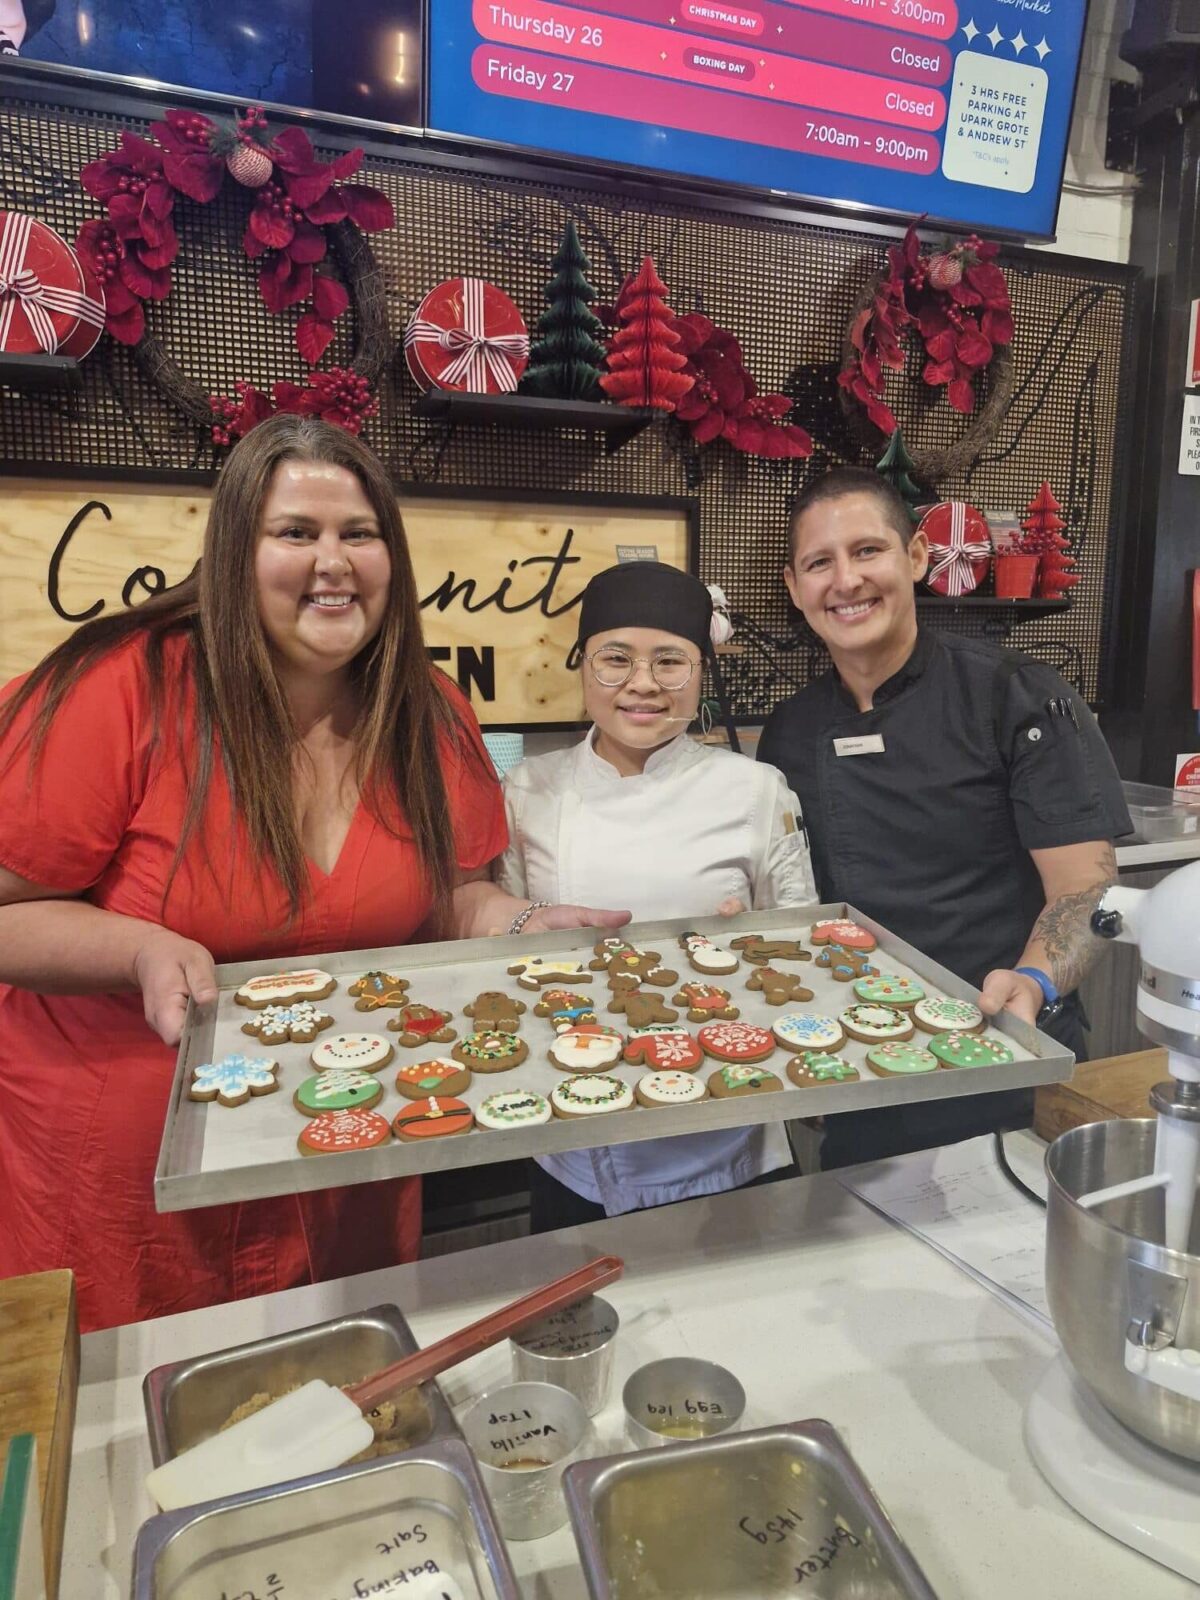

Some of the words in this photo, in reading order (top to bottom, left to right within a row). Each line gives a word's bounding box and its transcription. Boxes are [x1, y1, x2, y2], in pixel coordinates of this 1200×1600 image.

[488, 4, 576, 44] Thursday
[580, 25, 603, 47] 26
[689, 5, 738, 25] CHRISTMAS
[740, 17, 757, 29] DAY
[891, 0, 945, 26] 3:00pm
[693, 55, 727, 70] BOXING
[728, 62, 746, 74] DAY
[890, 46, 940, 73] Closed
[487, 58, 547, 90] Friday
[552, 72, 575, 92] 27
[885, 92, 935, 118] Closed
[971, 85, 977, 95] 3
[980, 87, 1000, 100] HRS
[1002, 92, 1027, 107] FREE
[968, 99, 1012, 118] PARKING
[1014, 110, 1027, 121] AT
[961, 112, 994, 129] UPARK
[996, 120, 1030, 136] GROTE
[805, 122, 860, 149] 7:00am
[875, 136, 929, 162] 9:00pm
[958, 127, 964, 137] &
[967, 129, 1012, 147] ANDREW
[1014, 138, 1027, 150] ST
[684, 1399, 723, 1415] Egg
[491, 1425, 557, 1452] Vanilla
[375, 1524, 427, 1554] Salt
[739, 1508, 803, 1544] 145g
[352, 1559, 439, 1599] Baking
